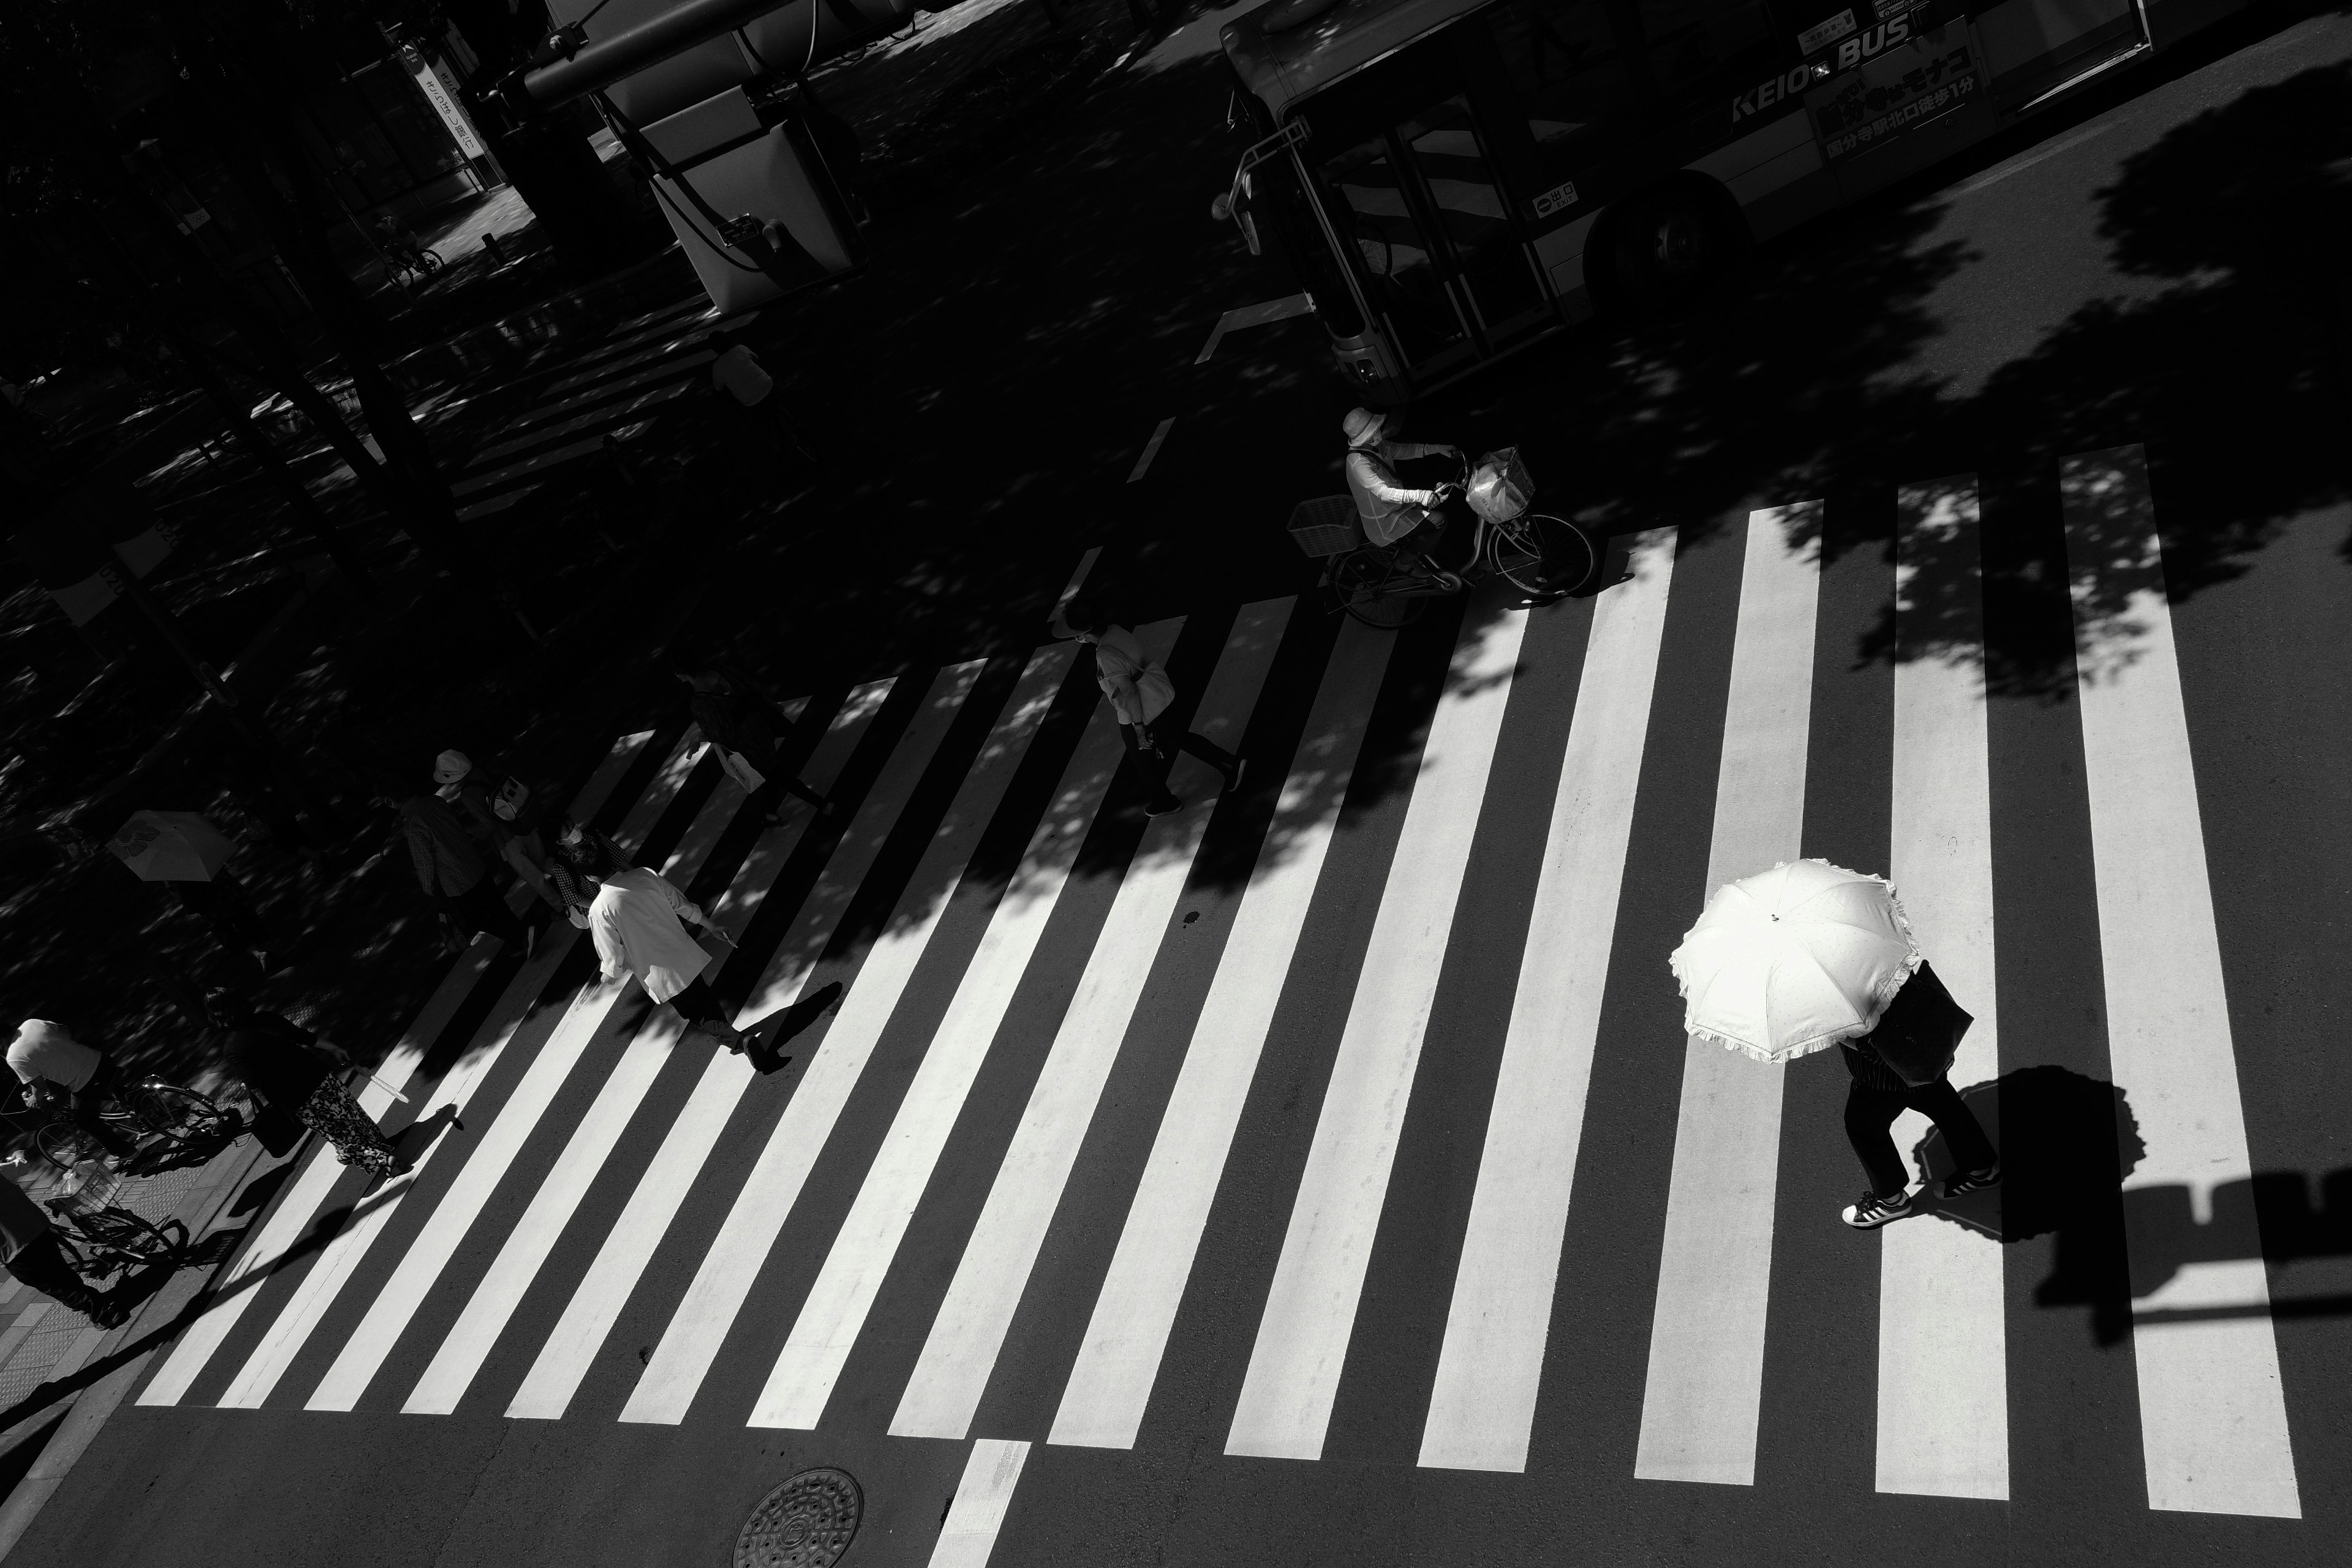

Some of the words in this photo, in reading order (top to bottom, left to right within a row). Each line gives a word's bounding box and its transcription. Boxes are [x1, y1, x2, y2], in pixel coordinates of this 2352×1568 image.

[1732, 64, 1810, 123] KEIO
[1838, 12, 1909, 71] BUS
[426, 80, 475, 150] きらぼし銀行
[1825, 76, 1975, 160] 国分寺駅北口徒歩1分
[1551, 184, 1574, 202] 出口
[1556, 195, 1572, 208] EXIT
